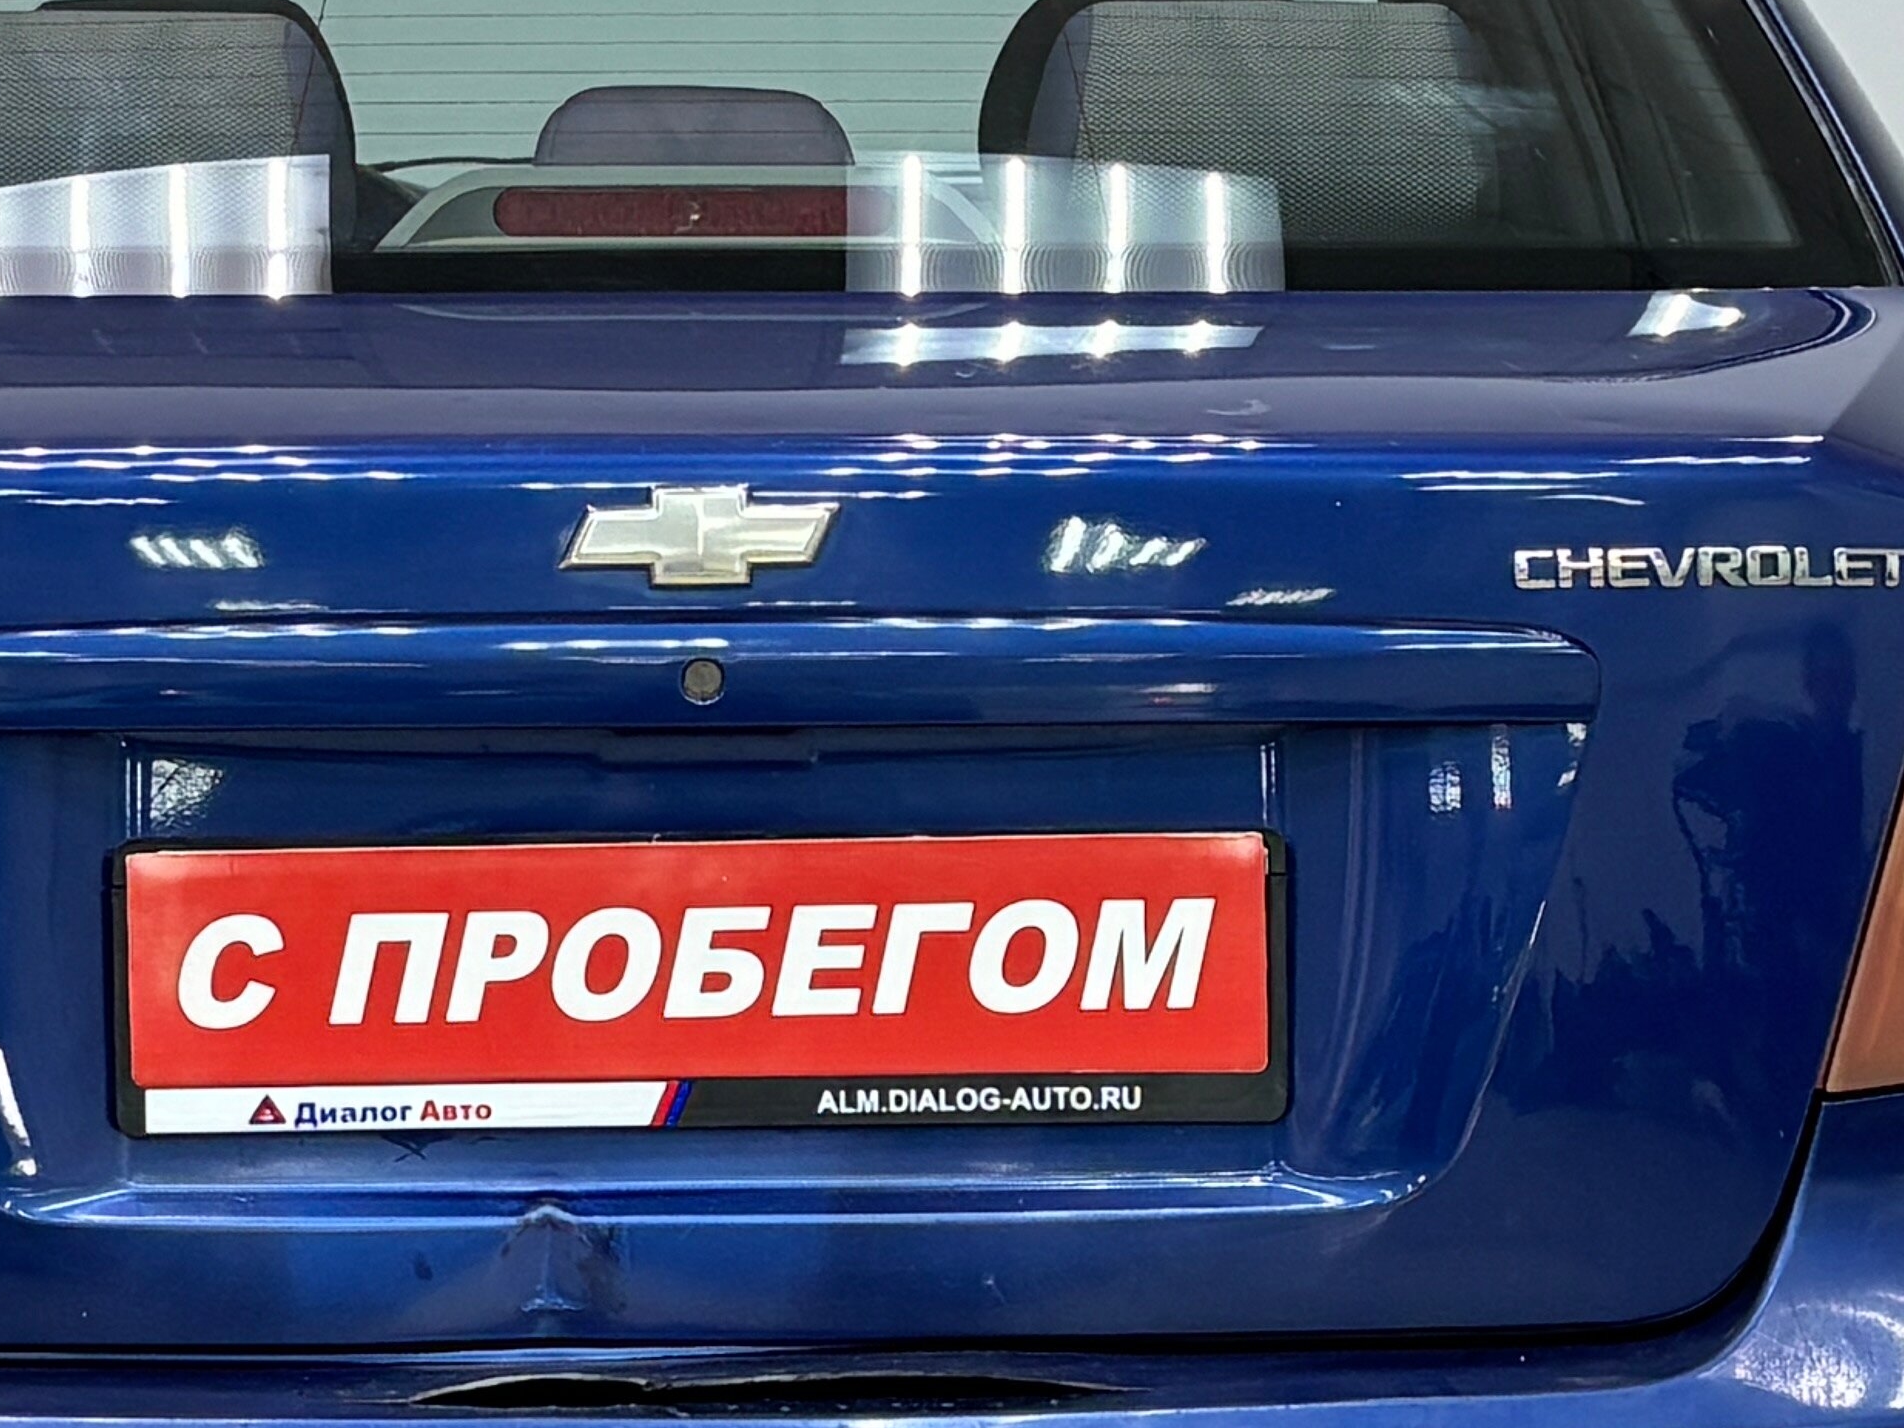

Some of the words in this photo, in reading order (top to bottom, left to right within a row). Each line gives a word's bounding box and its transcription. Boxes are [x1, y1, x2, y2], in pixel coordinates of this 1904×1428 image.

[175, 911, 285, 1032] С
[326, 896, 1217, 1027] ПРОБЕГОМ
[293, 1101, 412, 1129] Диалог
[419, 1099, 493, 1124] Авто
[815, 1085, 1144, 1115] ALM.DIALOG-AUTO.RU
